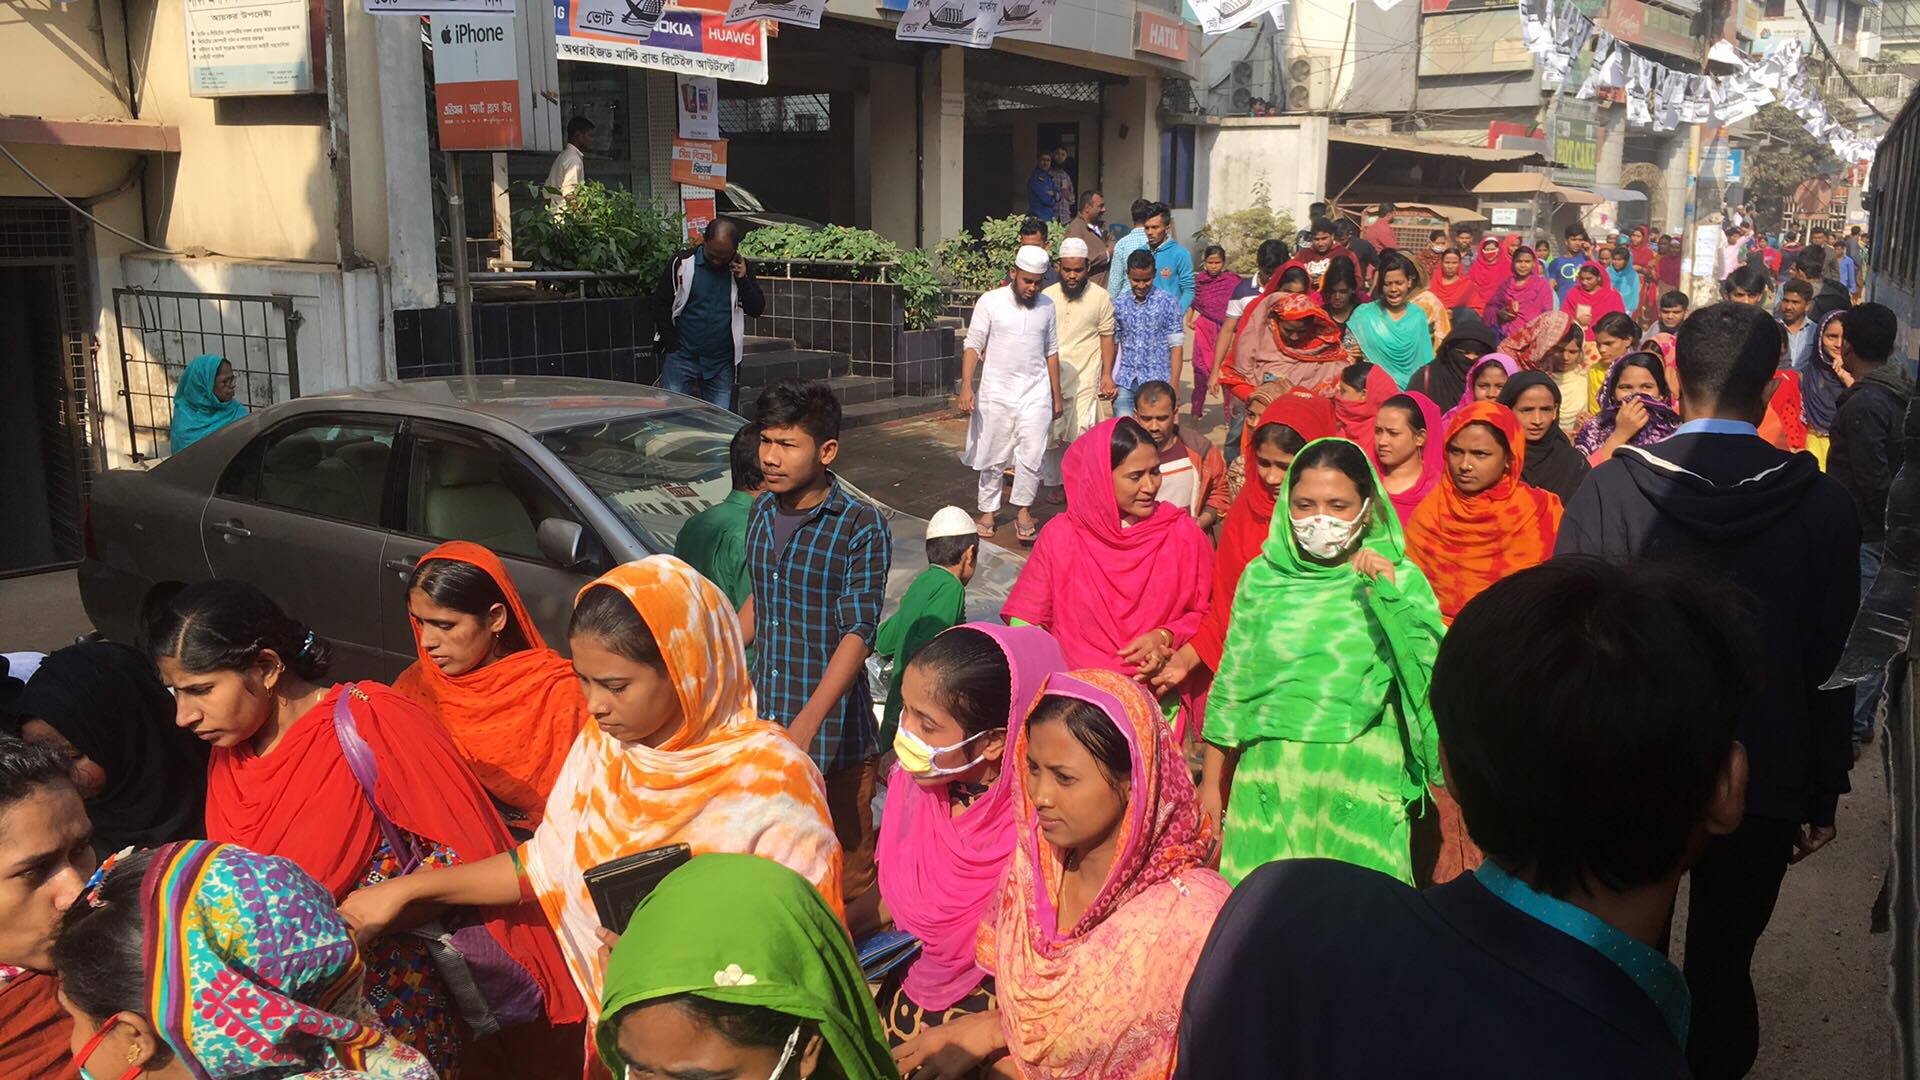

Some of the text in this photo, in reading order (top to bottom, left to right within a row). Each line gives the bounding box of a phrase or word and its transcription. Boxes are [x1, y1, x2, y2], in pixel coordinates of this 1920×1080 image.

[587, 11, 614, 26] ভোট
[455, 23, 504, 44] iPhone
[708, 28, 755, 46] HUAWEI
[1150, 23, 1179, 49] HATIL
[562, 43, 612, 58] অথরাইজড
[661, 52, 693, 68] রিটেইল
[695, 58, 735, 73] আউটলেট
